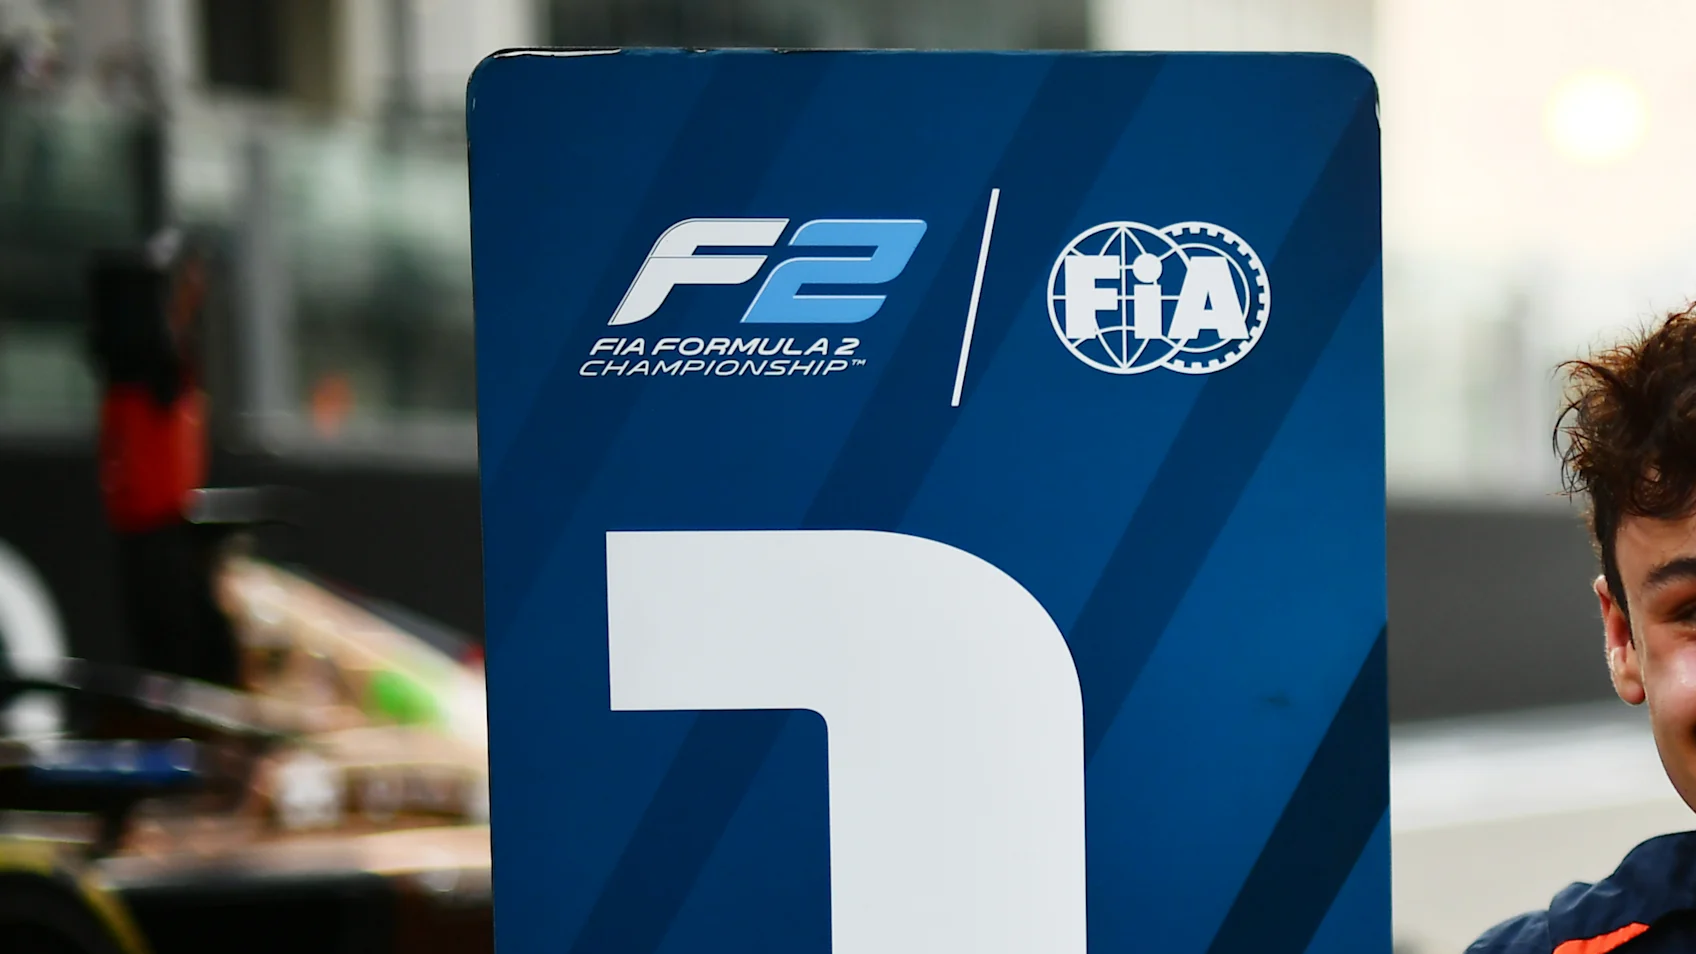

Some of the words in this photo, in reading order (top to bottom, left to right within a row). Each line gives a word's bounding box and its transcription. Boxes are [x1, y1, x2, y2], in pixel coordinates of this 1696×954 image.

[608, 217, 928, 326] F2
[589, 337, 645, 356] FIA
[651, 337, 829, 356] FORMULA
[834, 337, 861, 356] 2
